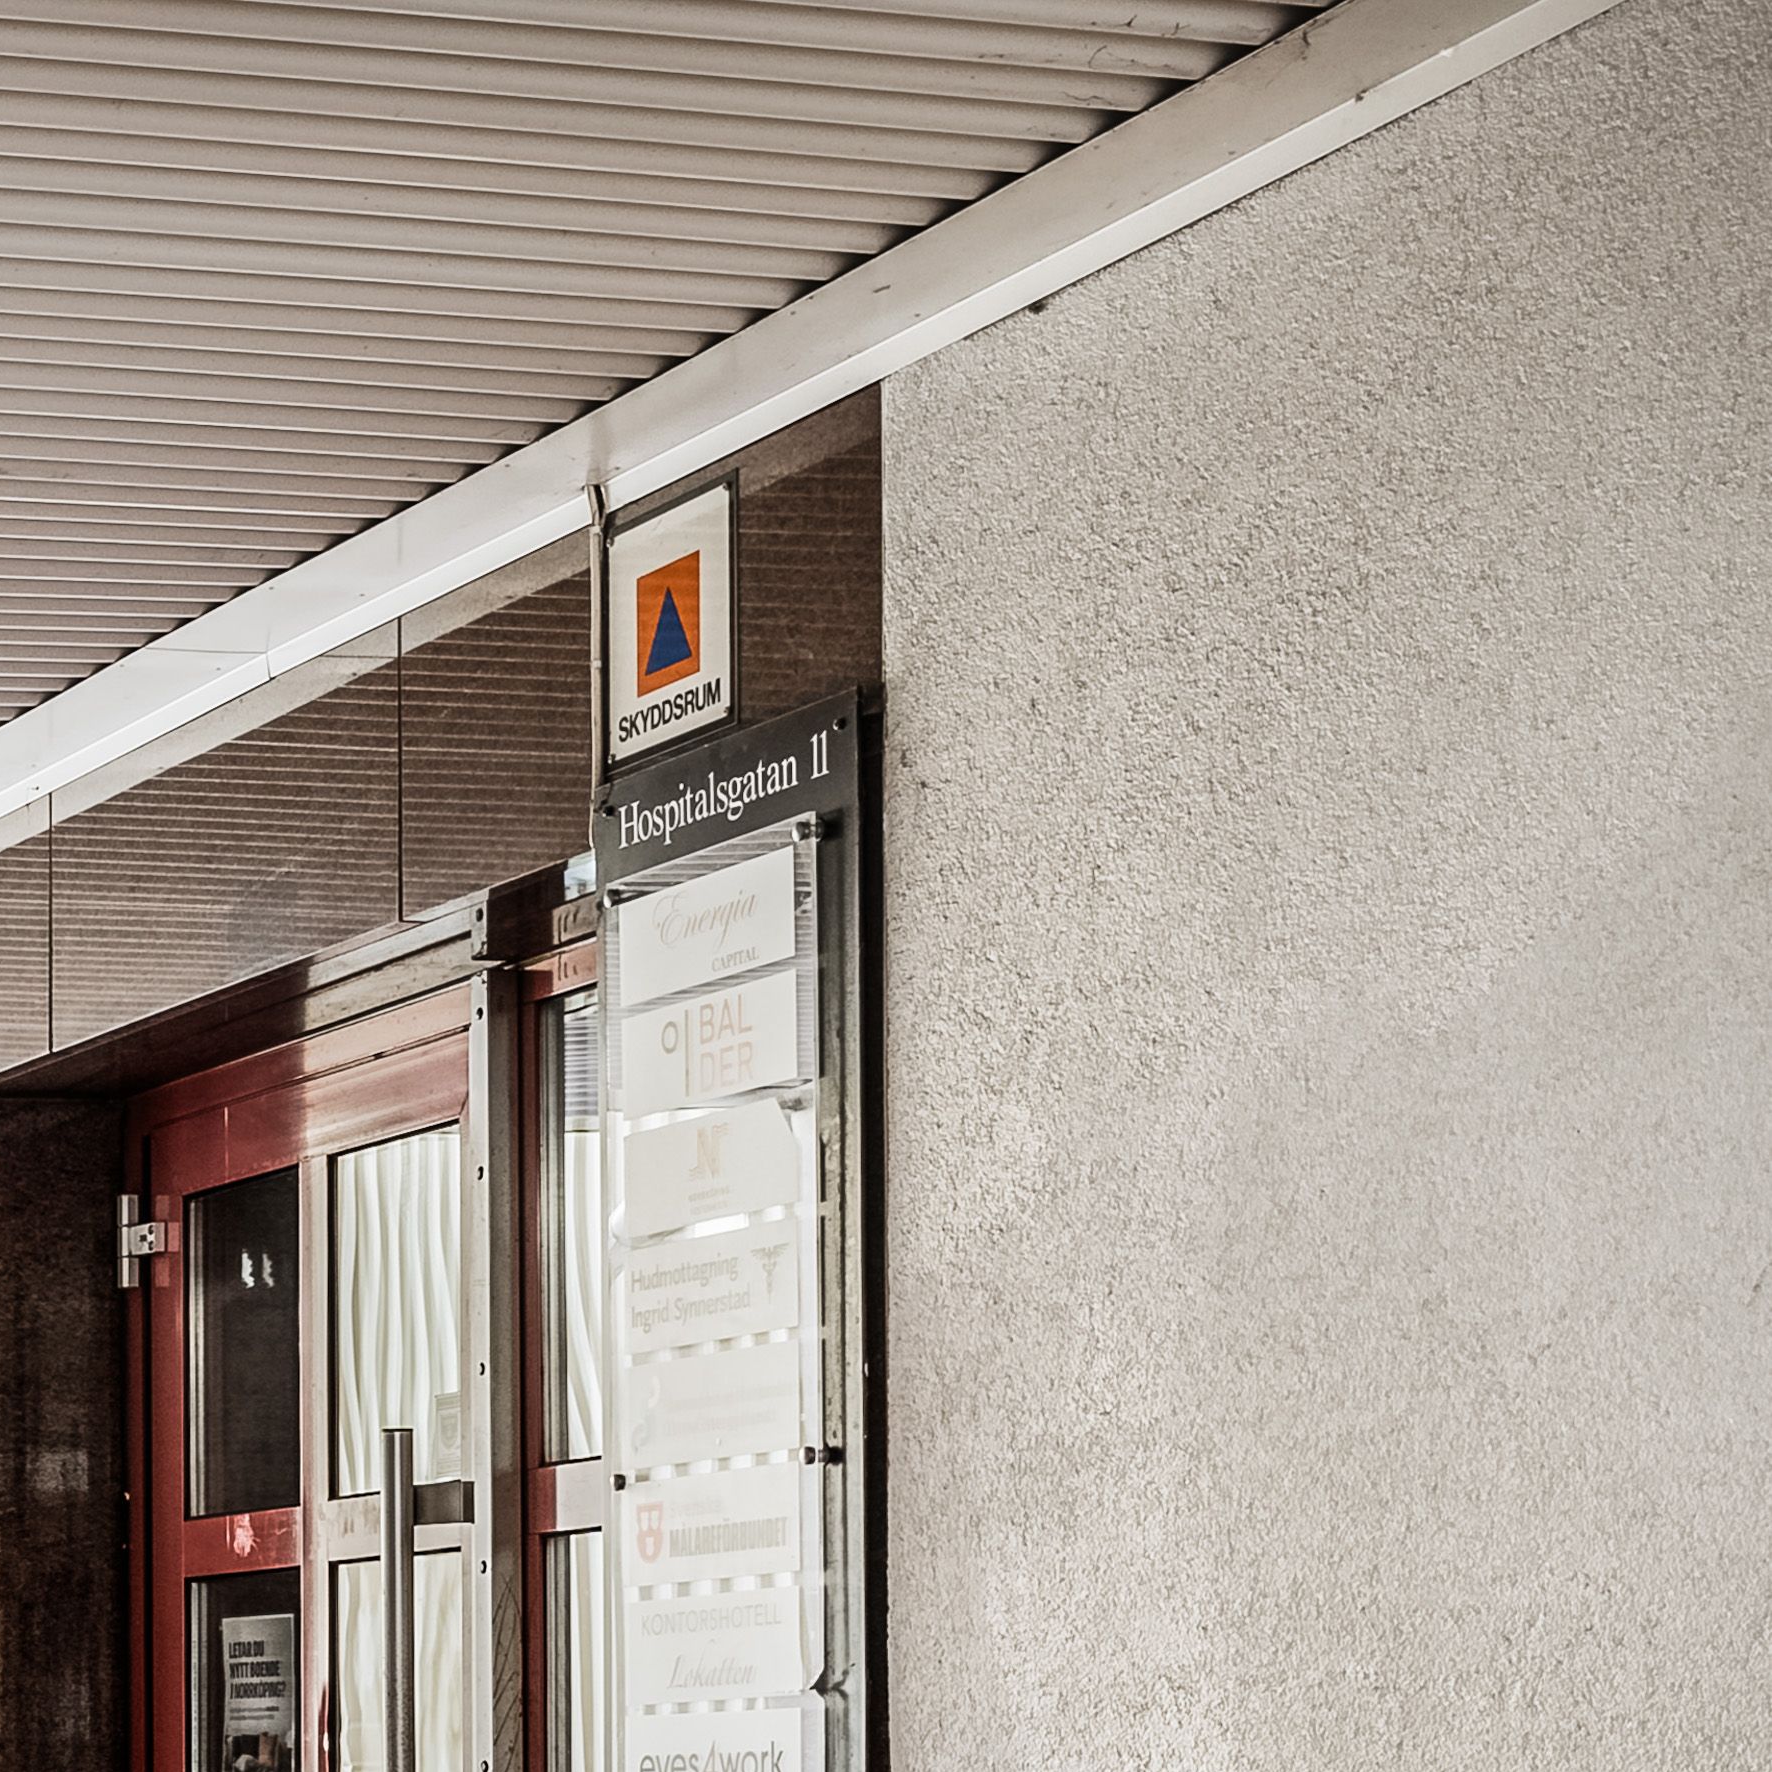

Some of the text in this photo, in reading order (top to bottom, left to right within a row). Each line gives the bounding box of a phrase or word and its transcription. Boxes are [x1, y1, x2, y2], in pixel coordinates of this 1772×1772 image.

[618, 678, 722, 743] SKYDDSRUM
[618, 730, 830, 850] Hospitalsgatan 11
[652, 890, 756, 953] Energia
[712, 947, 759, 972] CAPITAL
[698, 992, 753, 1046] BAL
[699, 1040, 754, 1093] DER
[631, 1252, 738, 1293] Hudmottagning
[631, 1281, 751, 1334] Ingrid Synnerstad
[669, 1516, 788, 1558] MÅLAREFÖRBUNDET
[642, 1602, 782, 1637] KONTORSHOTELL
[229, 1641, 251, 1658] LETAR
[229, 1662, 249, 1679] NYTT
